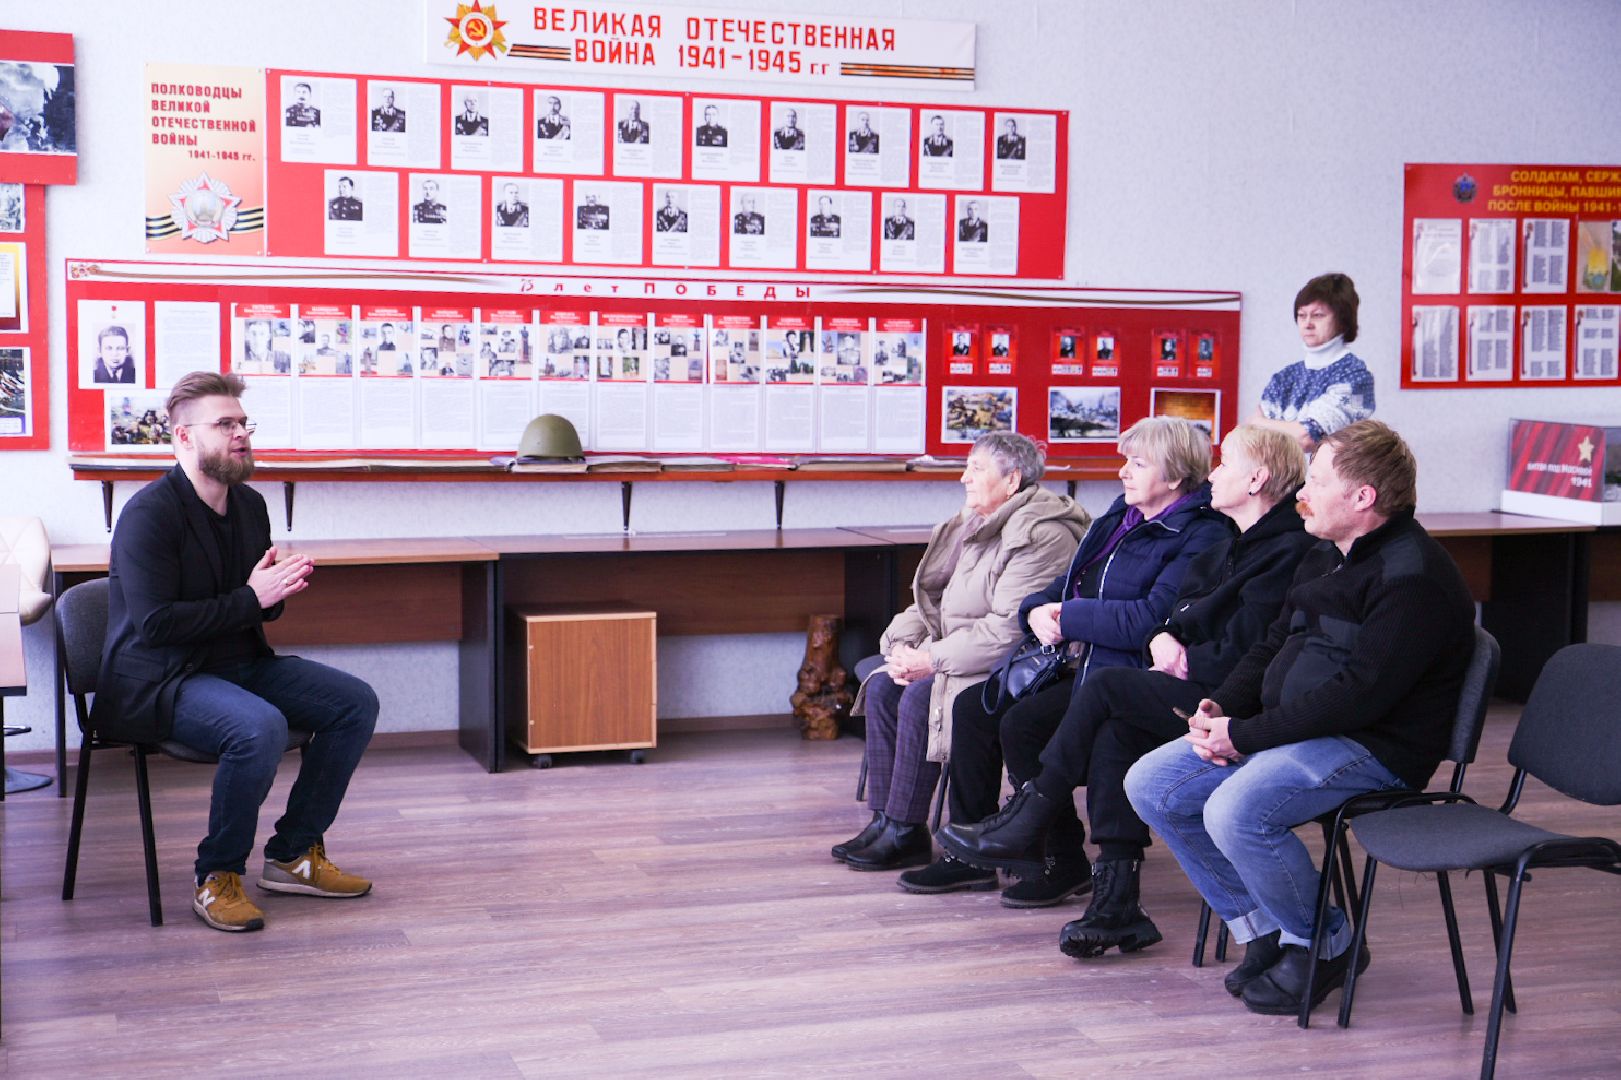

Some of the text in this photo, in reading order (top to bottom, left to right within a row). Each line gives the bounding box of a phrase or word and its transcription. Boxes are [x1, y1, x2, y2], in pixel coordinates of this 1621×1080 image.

[534, 7, 895, 51] ВЕЛИКАЯ ОТЕЧЕСТВЕННАЯ
[575, 38, 655, 65] ВОЙНА
[679, 45, 801, 73] 1941-1945
[151, 83, 242, 99] ПОЛКОВОДЦЫ
[152, 100, 210, 113] ВЕЛИКОЙ
[152, 116, 256, 132] ОТЕЧЕСТВЕННОЙ
[152, 132, 197, 146] ВОЙНЫ
[188, 150, 239, 160] 1941-1945
[1510, 170, 1582, 184] СОЛДАТАМ,
[1493, 185, 1568, 198] БРОННИЦЫ,
[1488, 200, 1531, 212] ПОСЛЕ
[1534, 199, 1579, 212] ВОЙНЫ
[644, 282, 810, 299] ПОБЕДЫ
